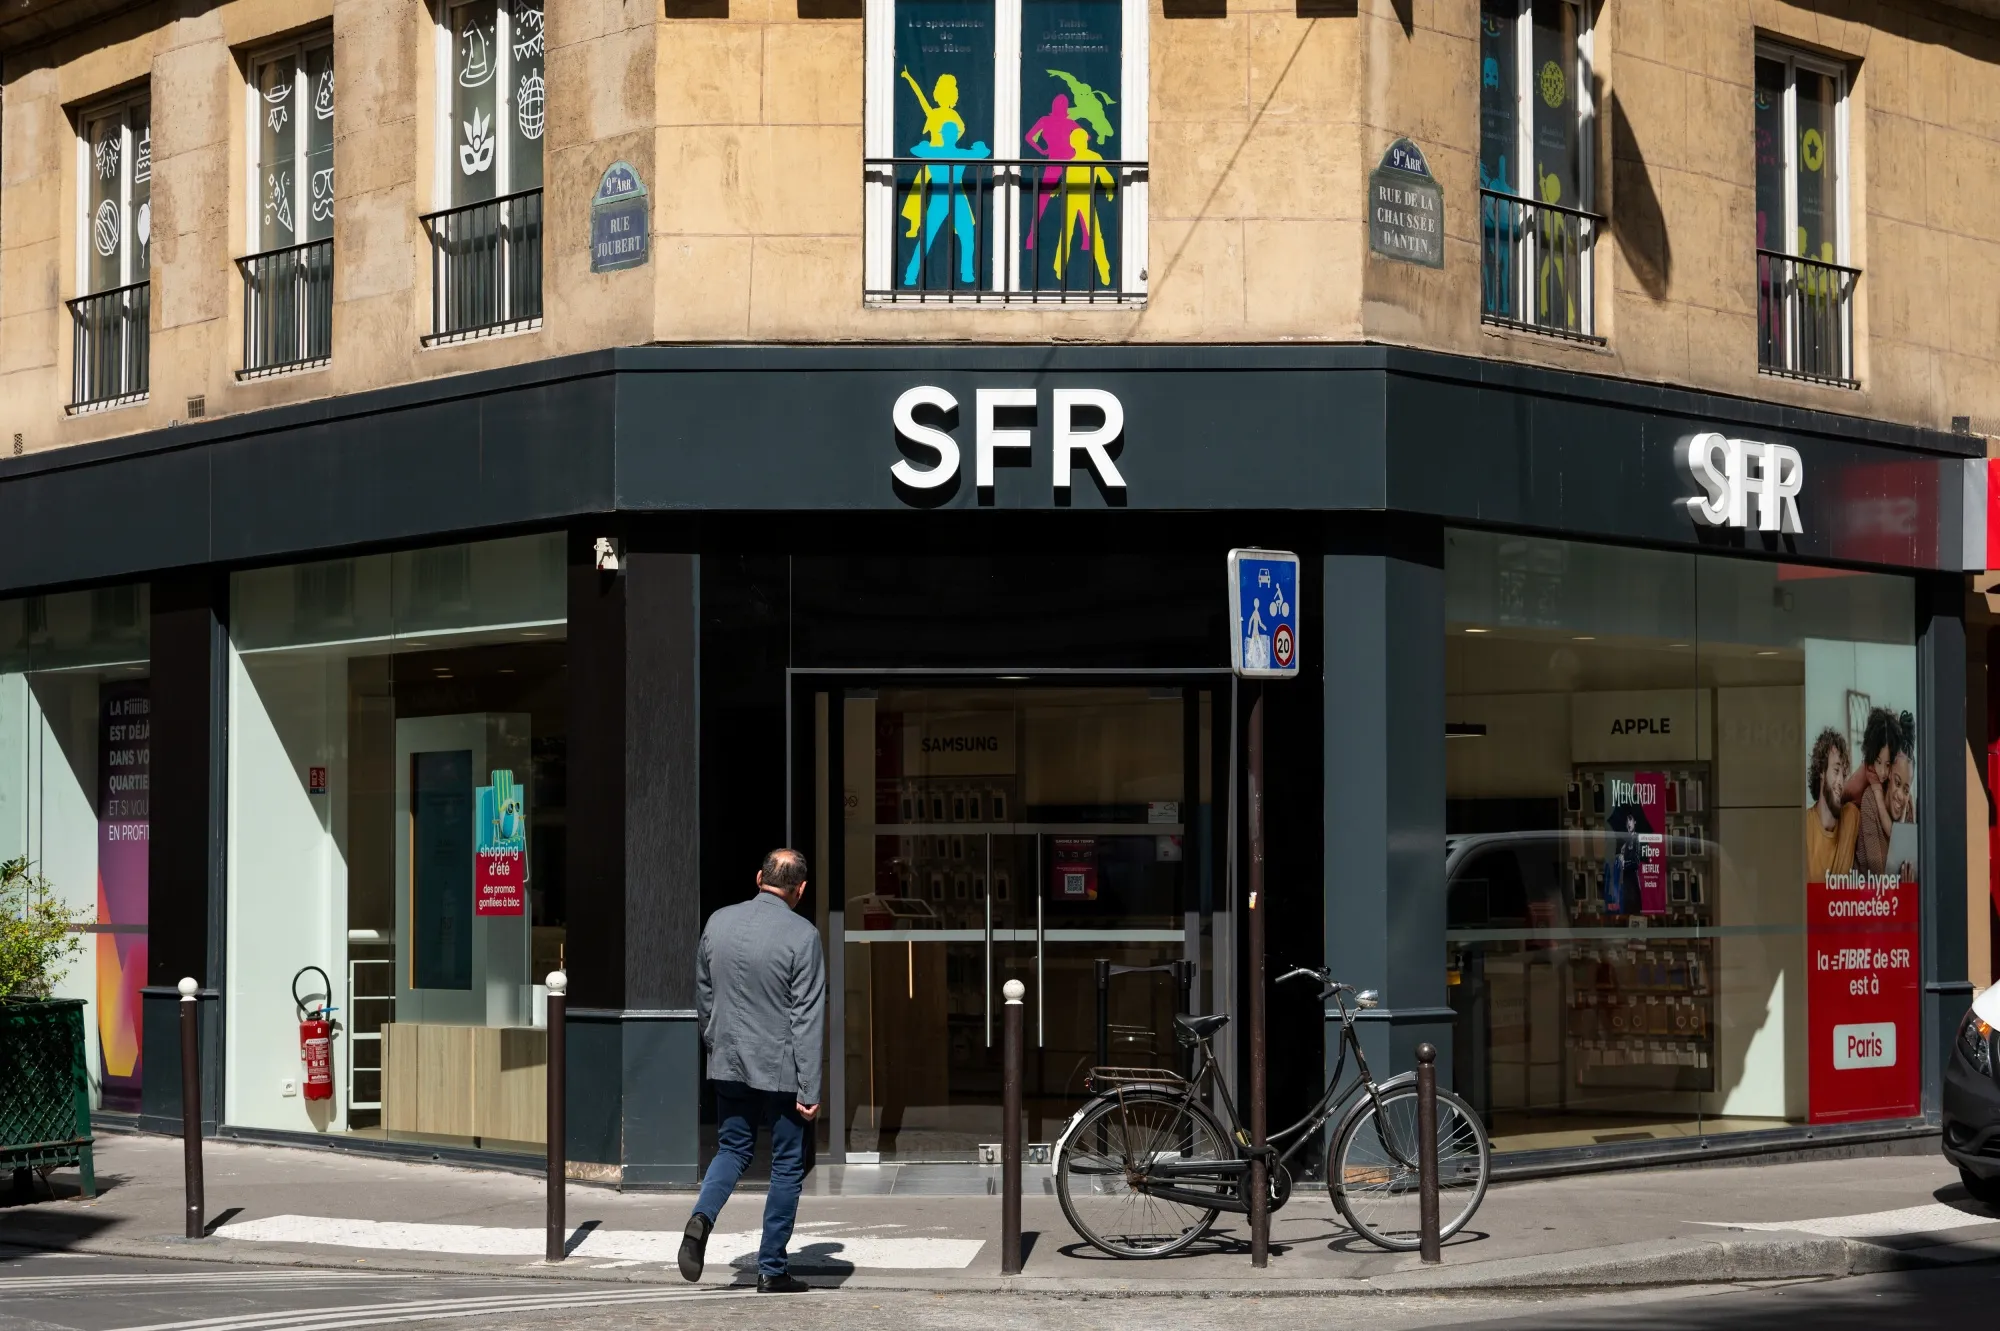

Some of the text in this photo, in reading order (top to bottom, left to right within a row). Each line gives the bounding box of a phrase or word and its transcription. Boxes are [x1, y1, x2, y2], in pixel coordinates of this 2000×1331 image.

[908, 18, 921, 28] Le
[1059, 19, 1087, 28] Table
[940, 31, 953, 40] de
[921, 44, 940, 53] vos
[1379, 186, 1433, 212] RUE DE LA
[610, 216, 630, 233] RUE
[1377, 207, 1435, 233] CHAUSSÉE
[597, 236, 641, 258] JOUBERT
[890, 385, 1127, 489] SFR
[1686, 432, 1803, 533] SFR
[1278, 638, 1290, 653] 20
[110, 697, 151, 716] LA FiiiiiB
[110, 719, 150, 741] EST DÉJÀ
[1611, 718, 1670, 735] APPLE
[921, 736, 998, 752] SAMSUNG
[110, 750, 134, 766] DANS
[109, 773, 150, 795] QUARTIE
[109, 800, 119, 816] ET
[131, 799, 149, 816] VOU
[109, 825, 120, 841] EN
[480, 844, 518, 861] shopping
[1641, 844, 1660, 858] Fibre
[489, 861, 510, 876] d'été
[1641, 864, 1660, 874] NETFLIX
[483, 884, 515, 896] des promos
[1644, 880, 1657, 888] inclus
[1825, 869, 1901, 896] famille hyper
[478, 896, 520, 910] gonflées à bloc
[1828, 894, 1890, 917] connectée
[1817, 950, 1829, 970] la
[1873, 948, 1888, 969] de
[1890, 949, 1910, 968] SFR
[1849, 972, 1879, 995] est à
[1847, 1032, 1882, 1058] Paris
